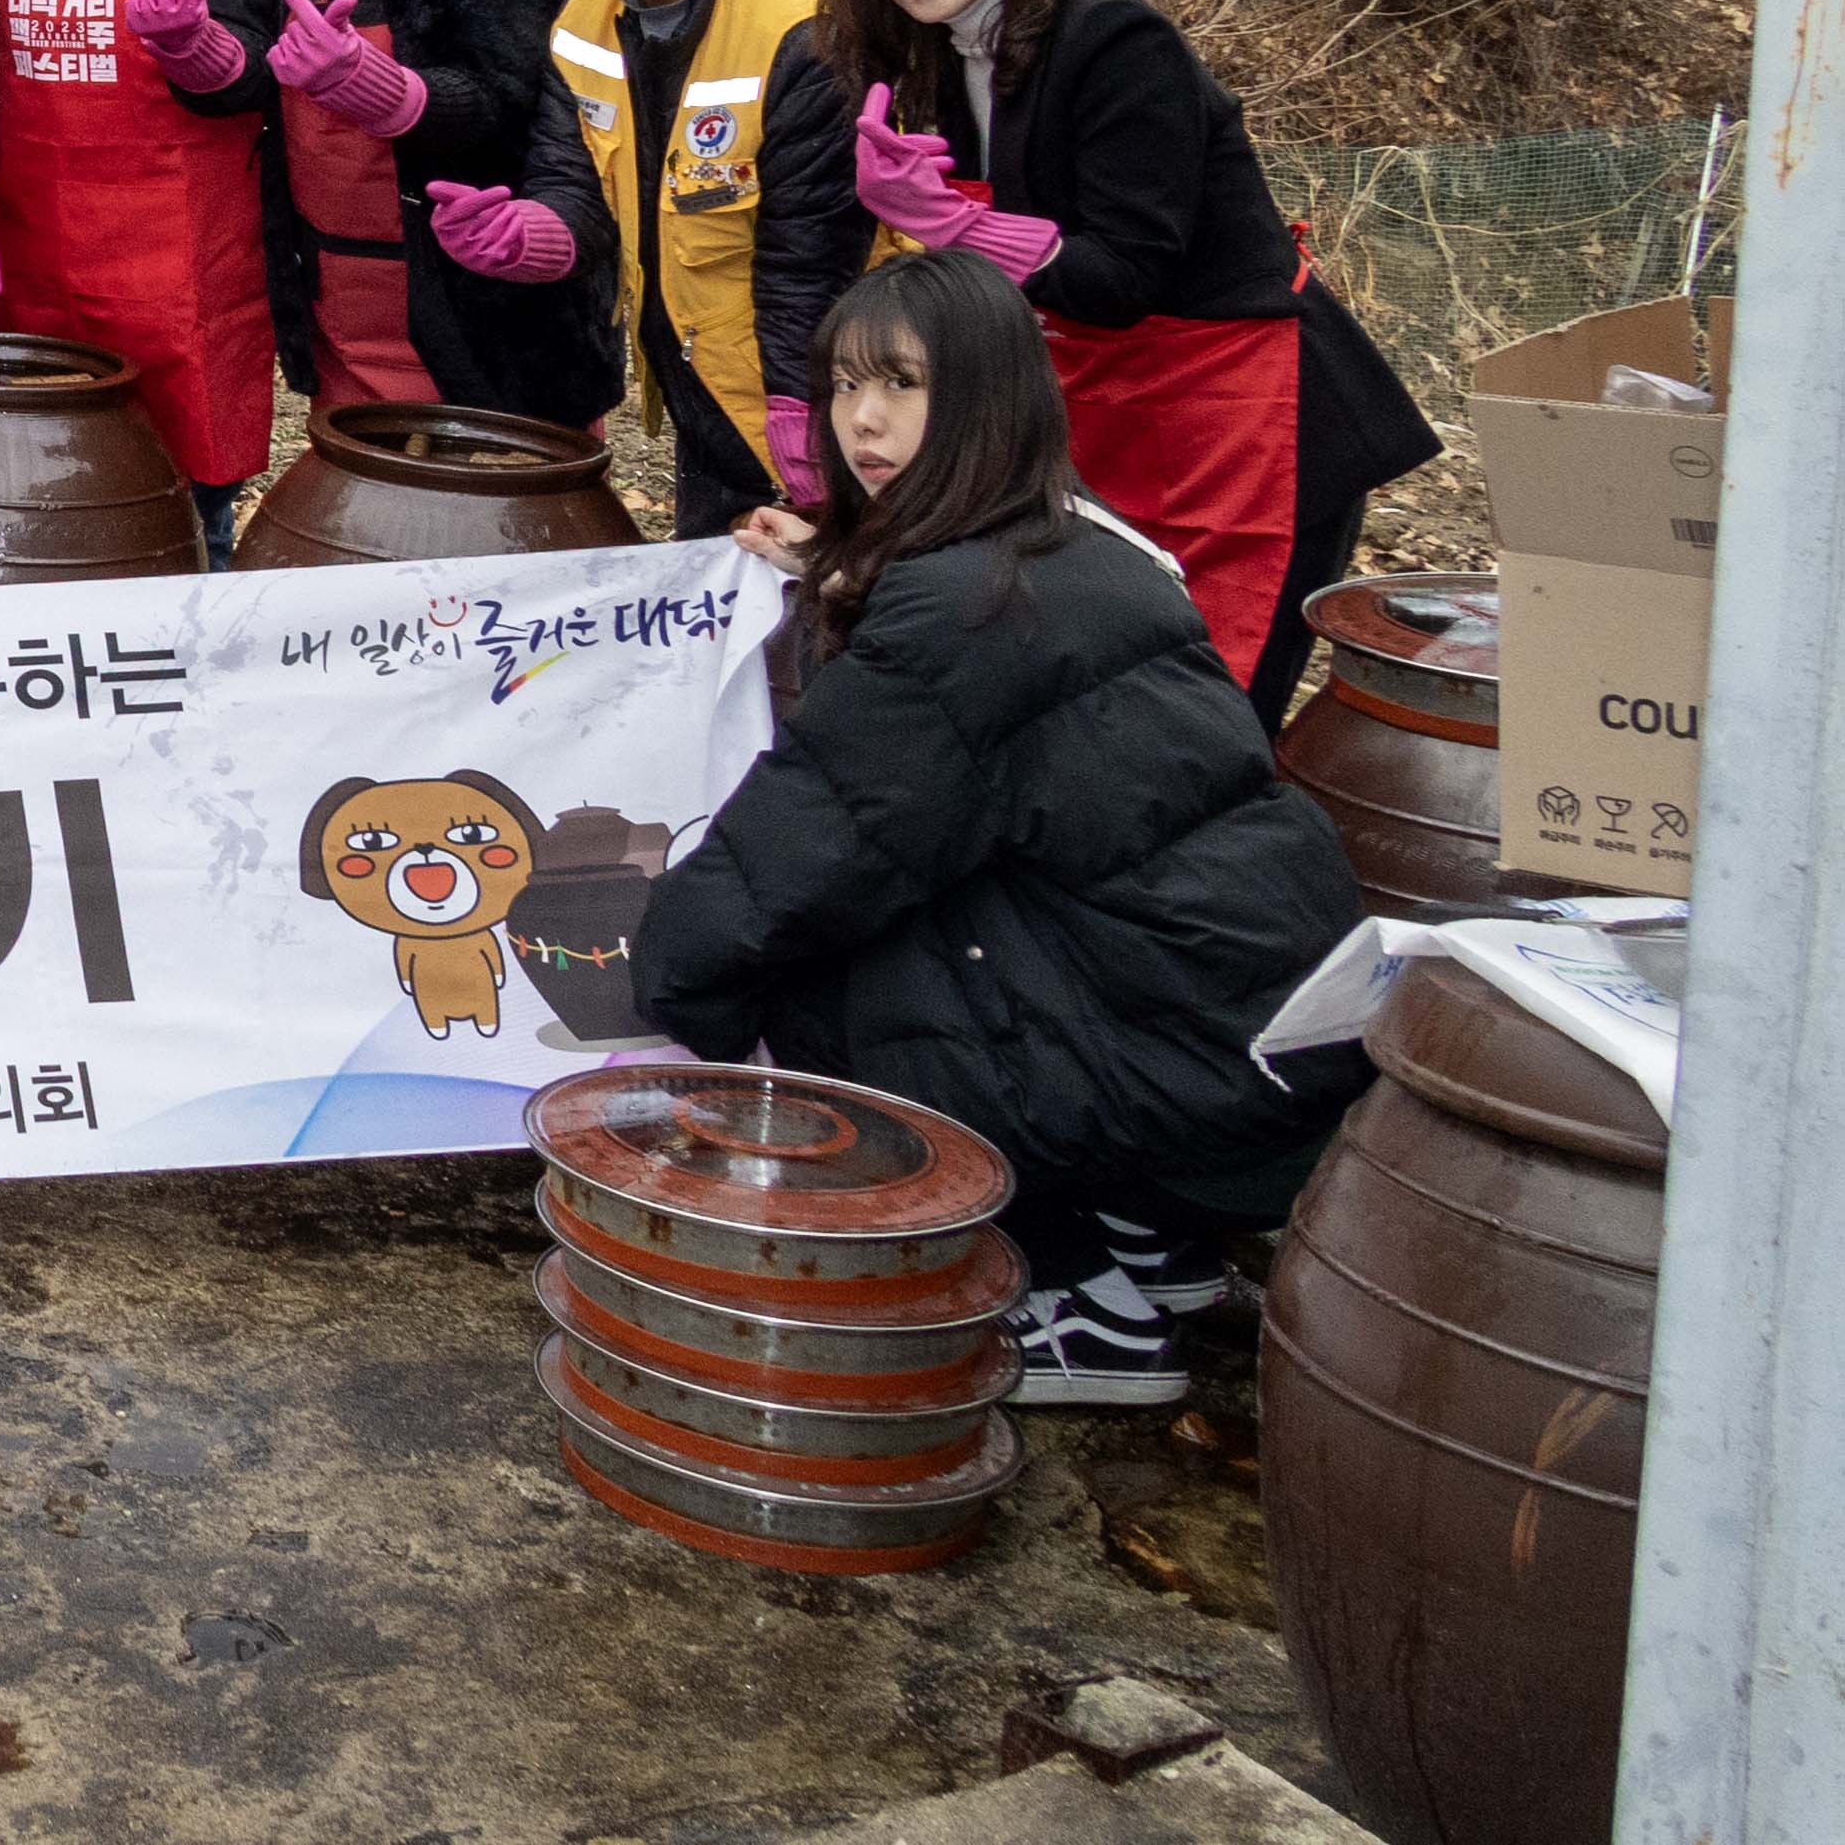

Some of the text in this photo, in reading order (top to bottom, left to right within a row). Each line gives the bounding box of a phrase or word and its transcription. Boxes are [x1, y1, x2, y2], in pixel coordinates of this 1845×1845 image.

[31, 20, 85, 33] 2023
[12, 50, 118, 82] 페스티벌
[280, 629, 332, 673] 내
[351, 618, 463, 676] 일상이
[474, 599, 600, 705] 즐거운
